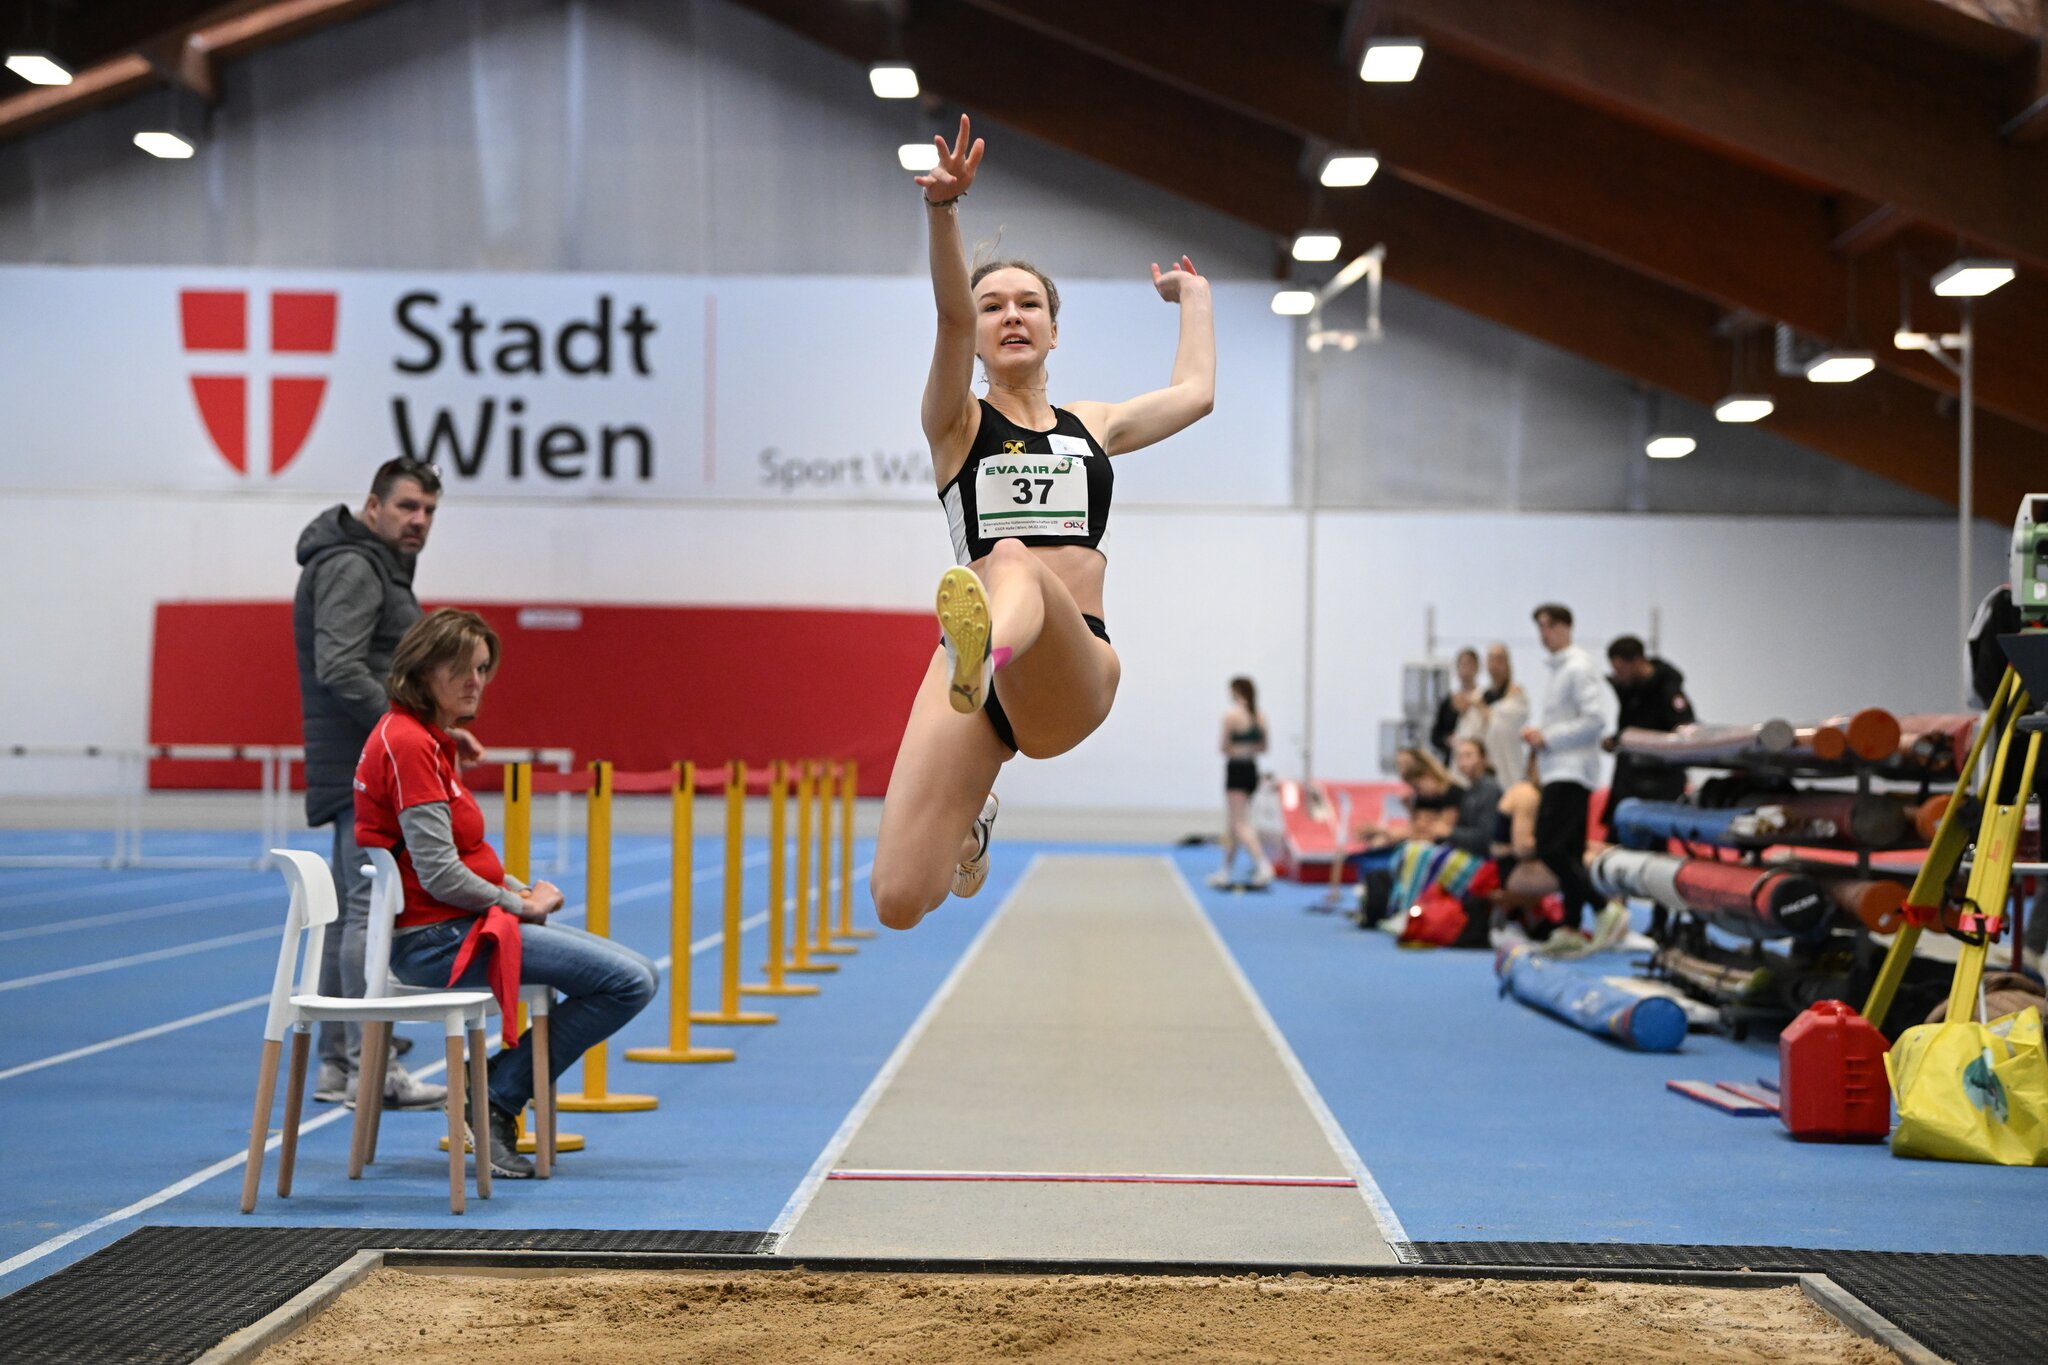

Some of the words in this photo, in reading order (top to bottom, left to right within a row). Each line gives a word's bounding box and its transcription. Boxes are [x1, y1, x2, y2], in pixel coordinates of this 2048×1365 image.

[393, 290, 657, 376] Stadt
[391, 397, 654, 480] Wien
[758, 446, 865, 494] Sport
[985, 465, 1018, 475] EVA
[1020, 465, 1049, 474] AIR
[1012, 478, 1054, 505] 37
